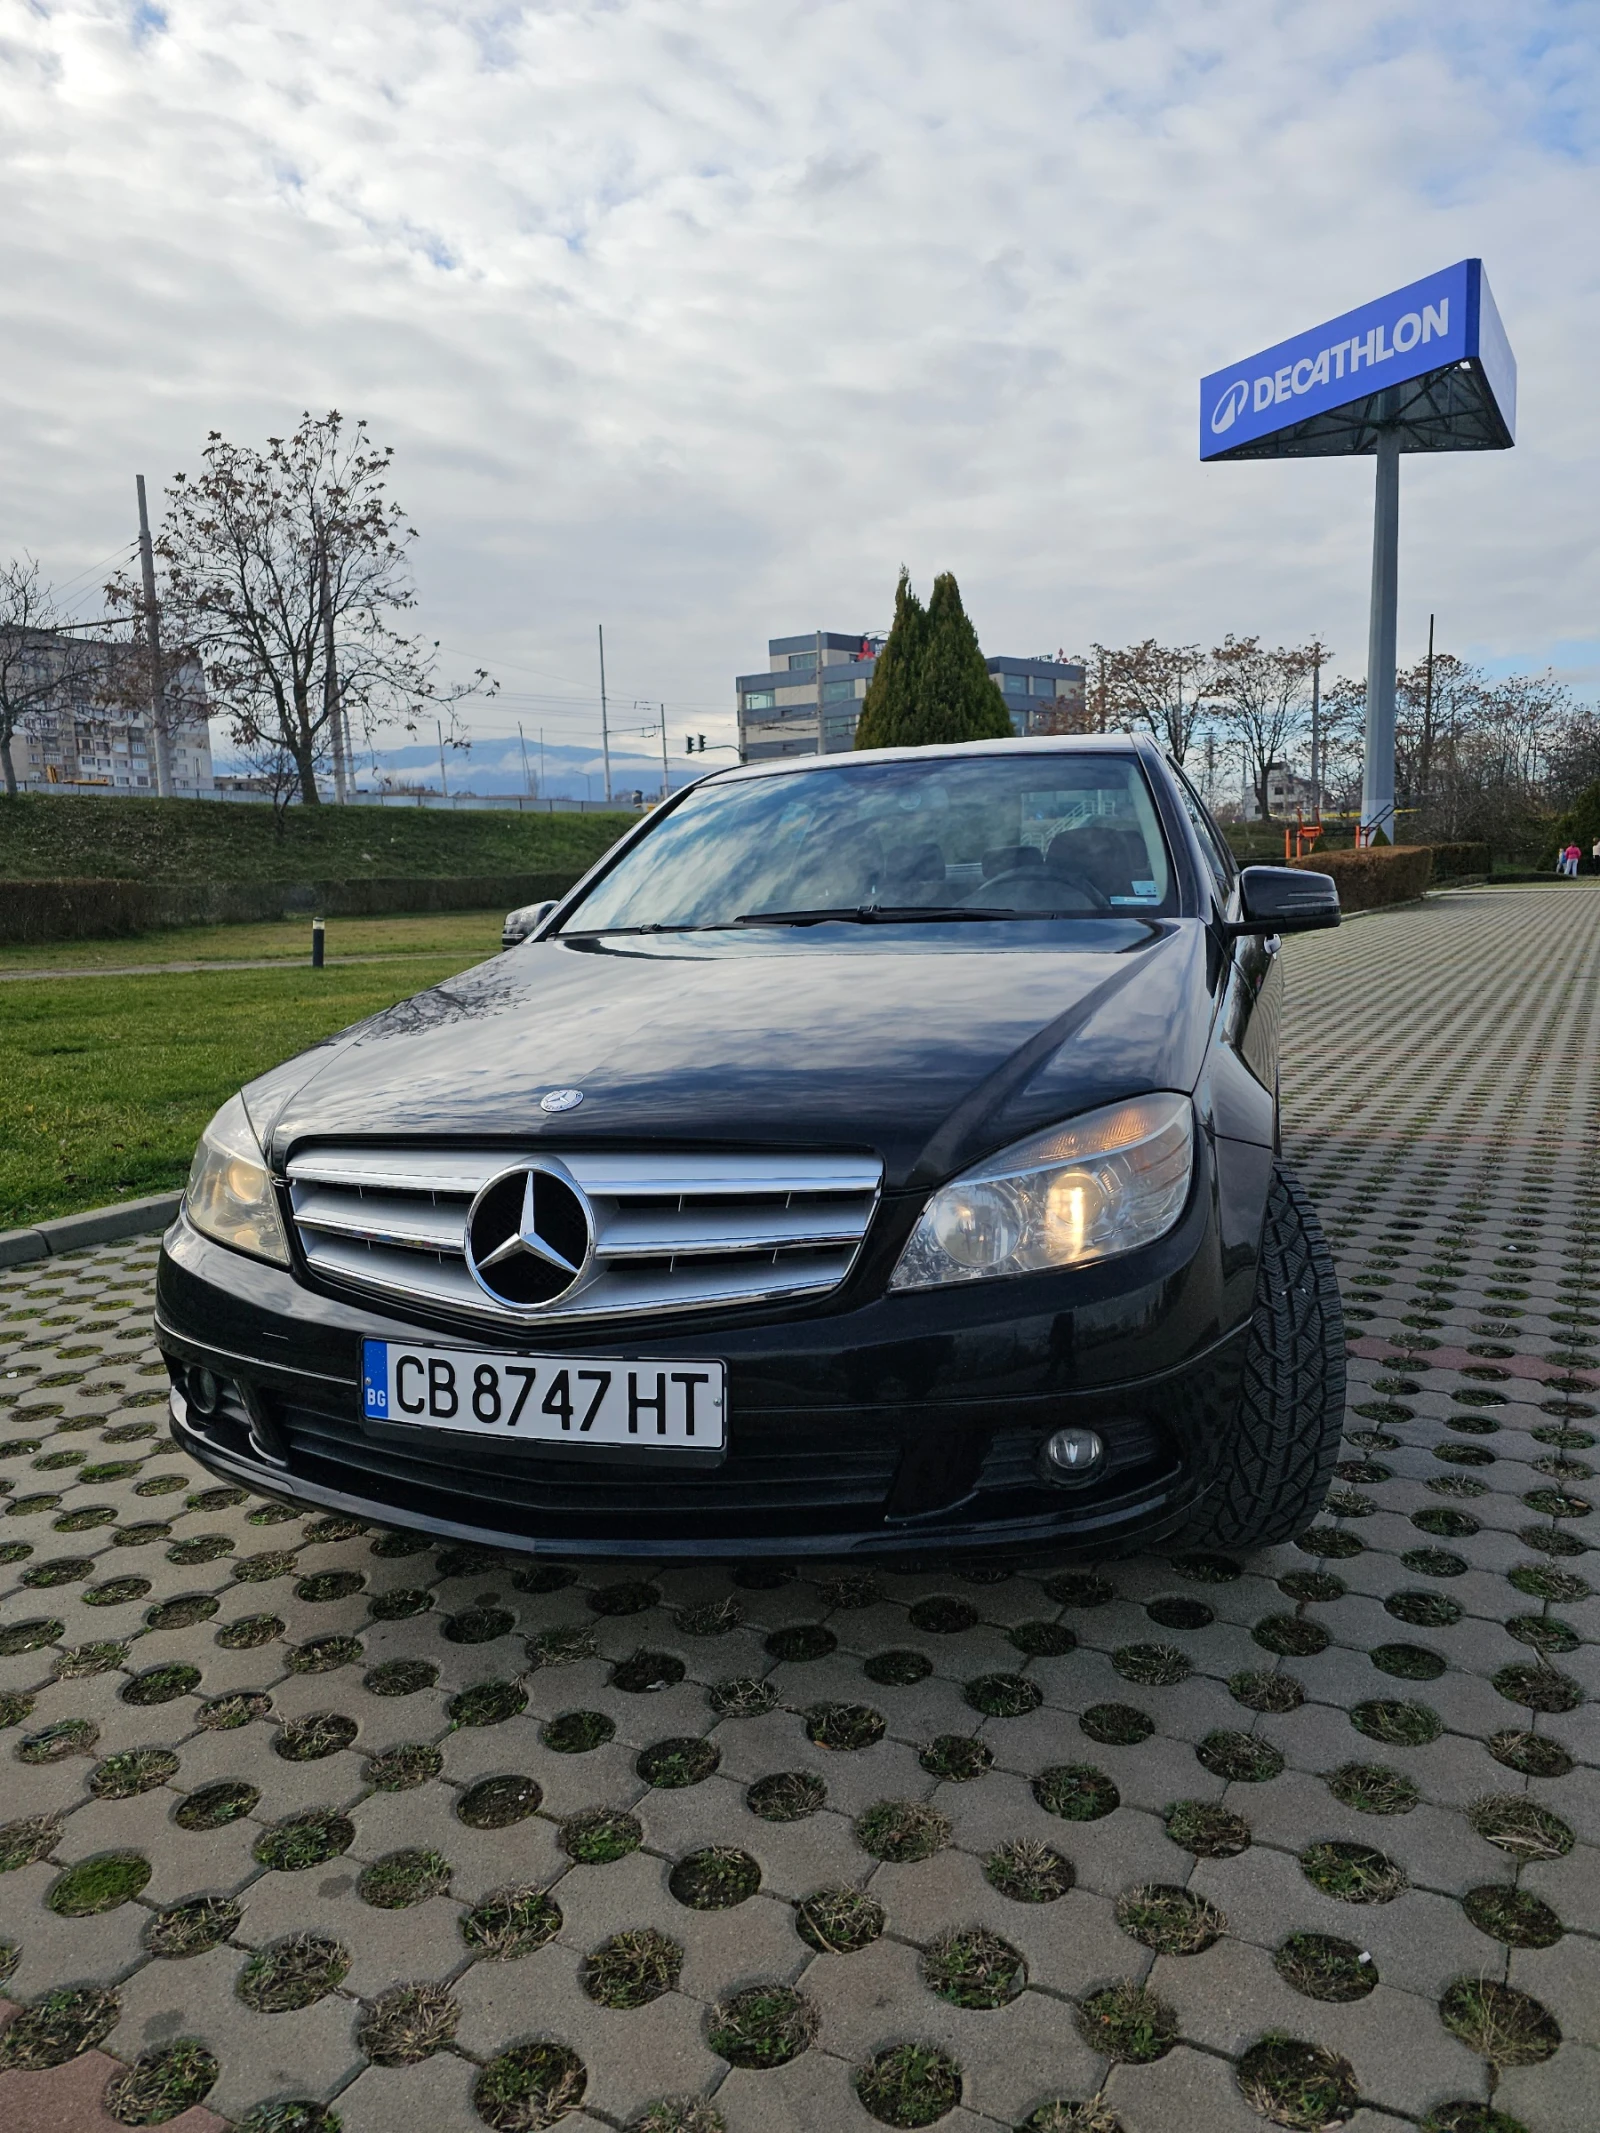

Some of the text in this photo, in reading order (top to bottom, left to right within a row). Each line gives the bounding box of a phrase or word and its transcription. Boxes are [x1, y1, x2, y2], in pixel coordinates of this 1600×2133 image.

[1253, 297, 1449, 413] DECATHLON
[367, 1388, 386, 1407] BG
[396, 1355, 709, 1436] CB 8747 HT
